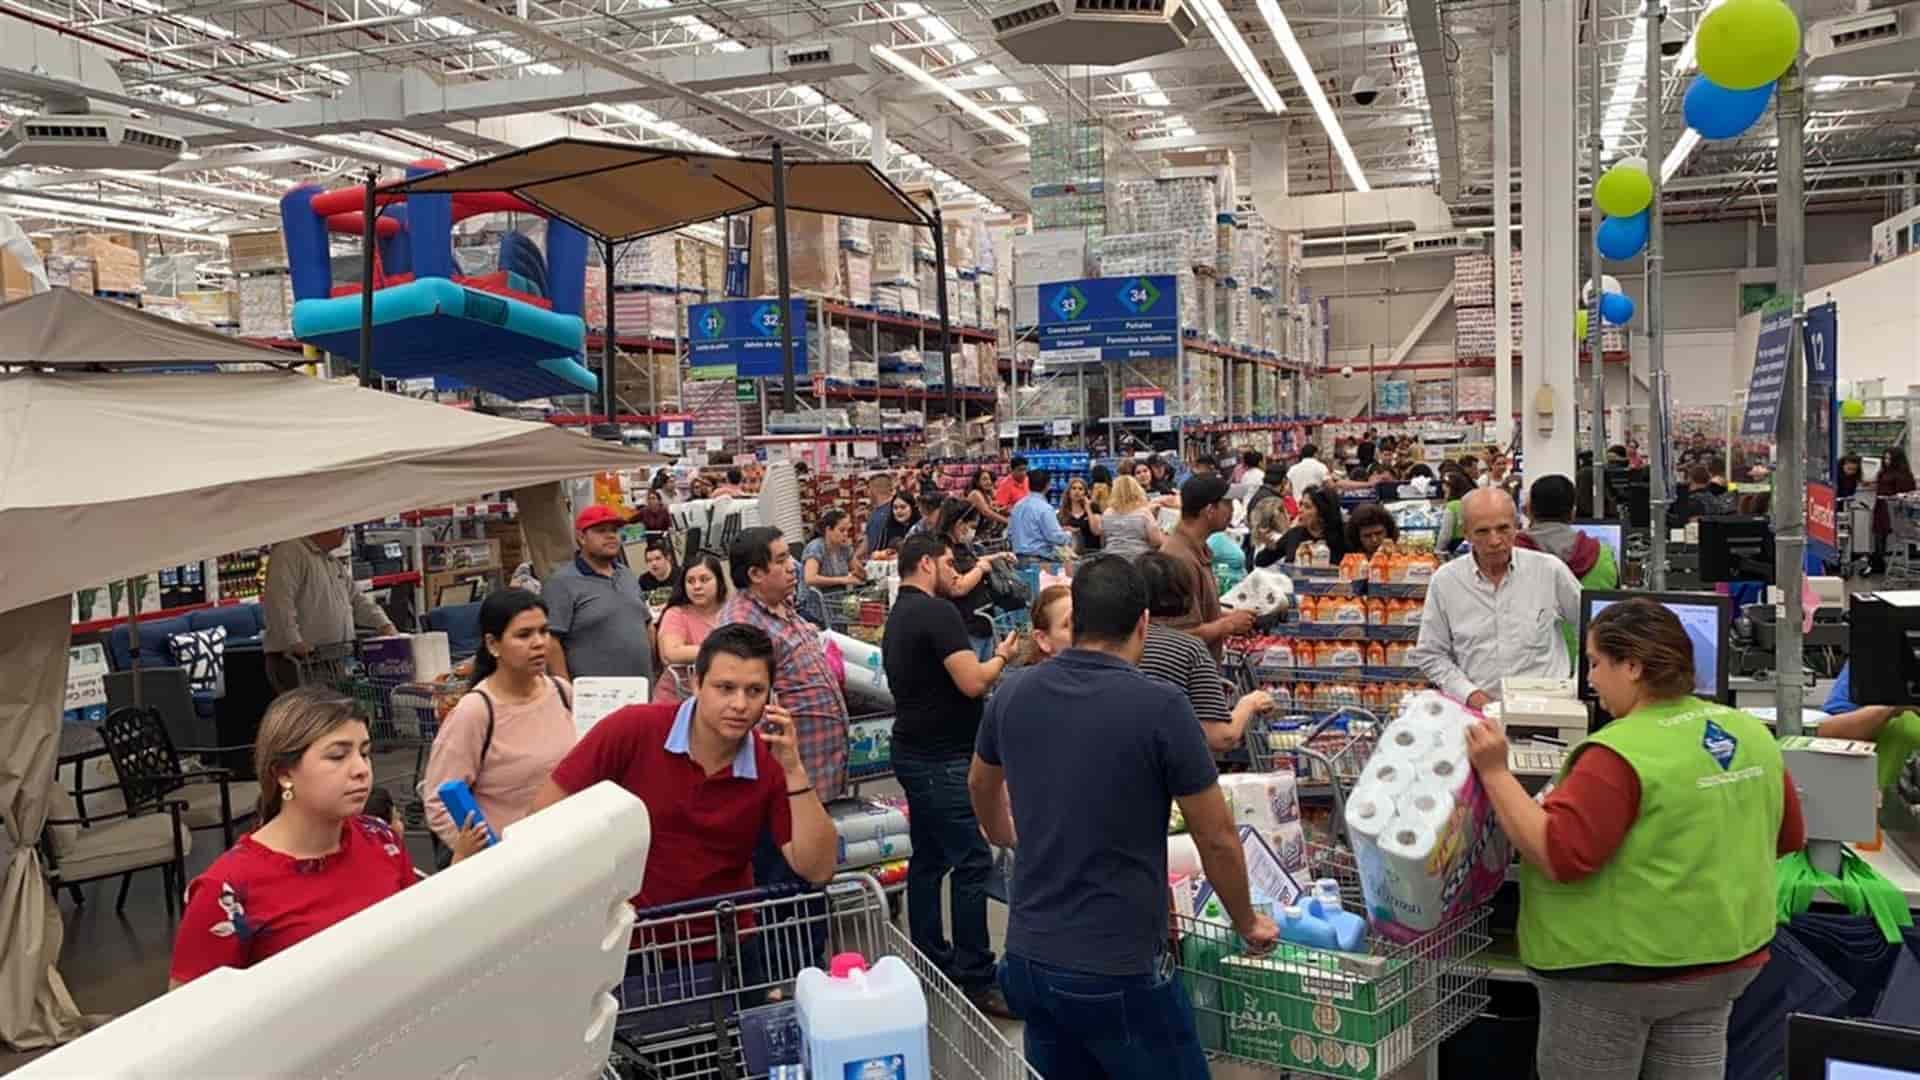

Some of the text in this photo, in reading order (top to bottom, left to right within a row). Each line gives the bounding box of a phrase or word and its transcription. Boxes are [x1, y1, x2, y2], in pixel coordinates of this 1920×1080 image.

[1129, 288, 1148, 303] 34
[1061, 298, 1076, 312] 33
[706, 317, 718, 330] 31
[763, 314, 779, 326] 32
[1811, 332, 1825, 371] 12
